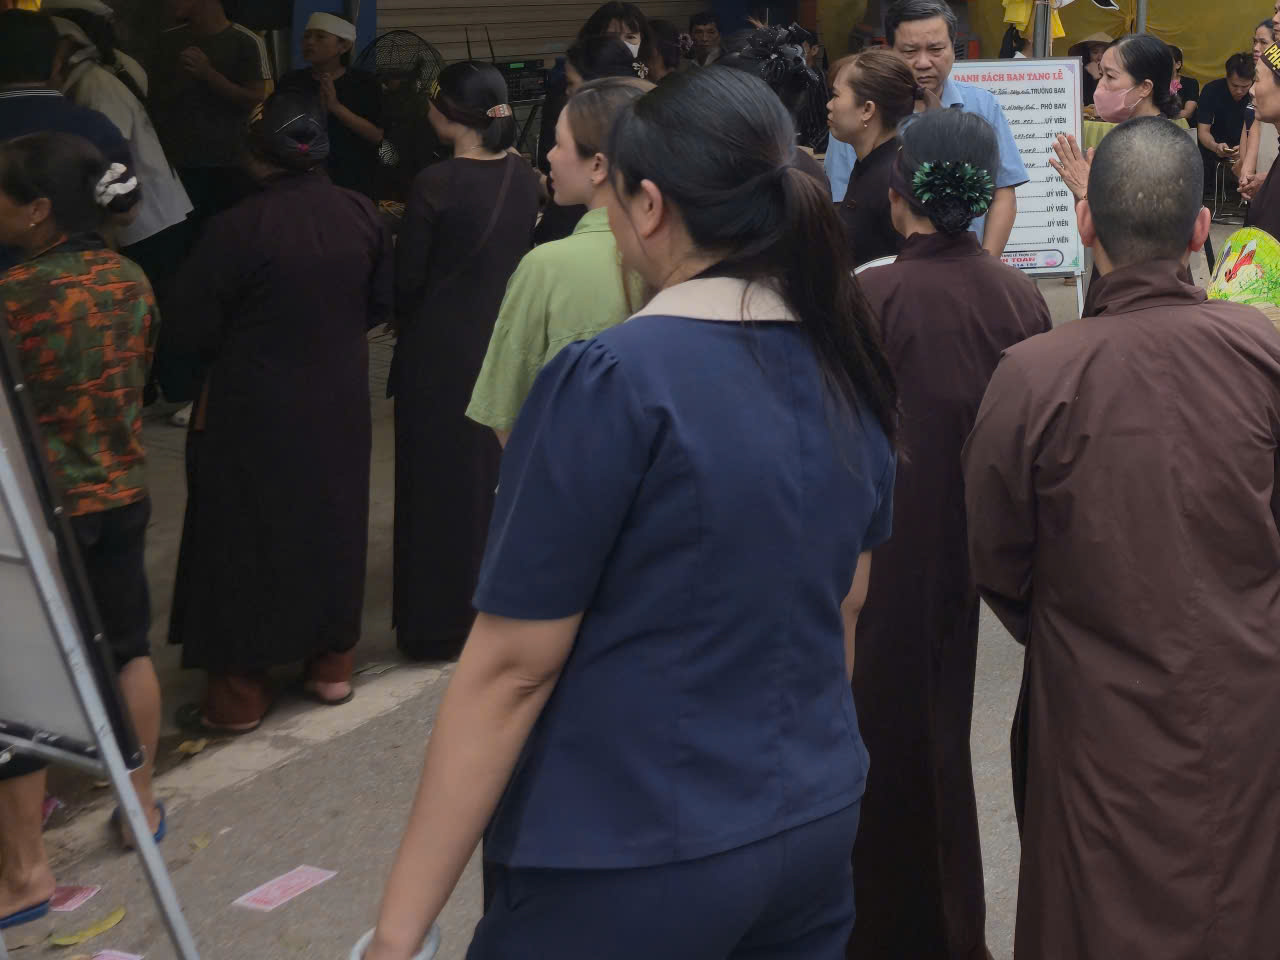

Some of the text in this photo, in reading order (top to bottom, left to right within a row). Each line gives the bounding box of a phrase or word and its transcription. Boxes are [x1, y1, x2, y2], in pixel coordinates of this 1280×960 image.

[981, 72, 1005, 82] SÁCH
[1006, 73, 1025, 81] BAN
[1027, 72, 1051, 81] TANG
[1052, 69, 1063, 80] LỄ
